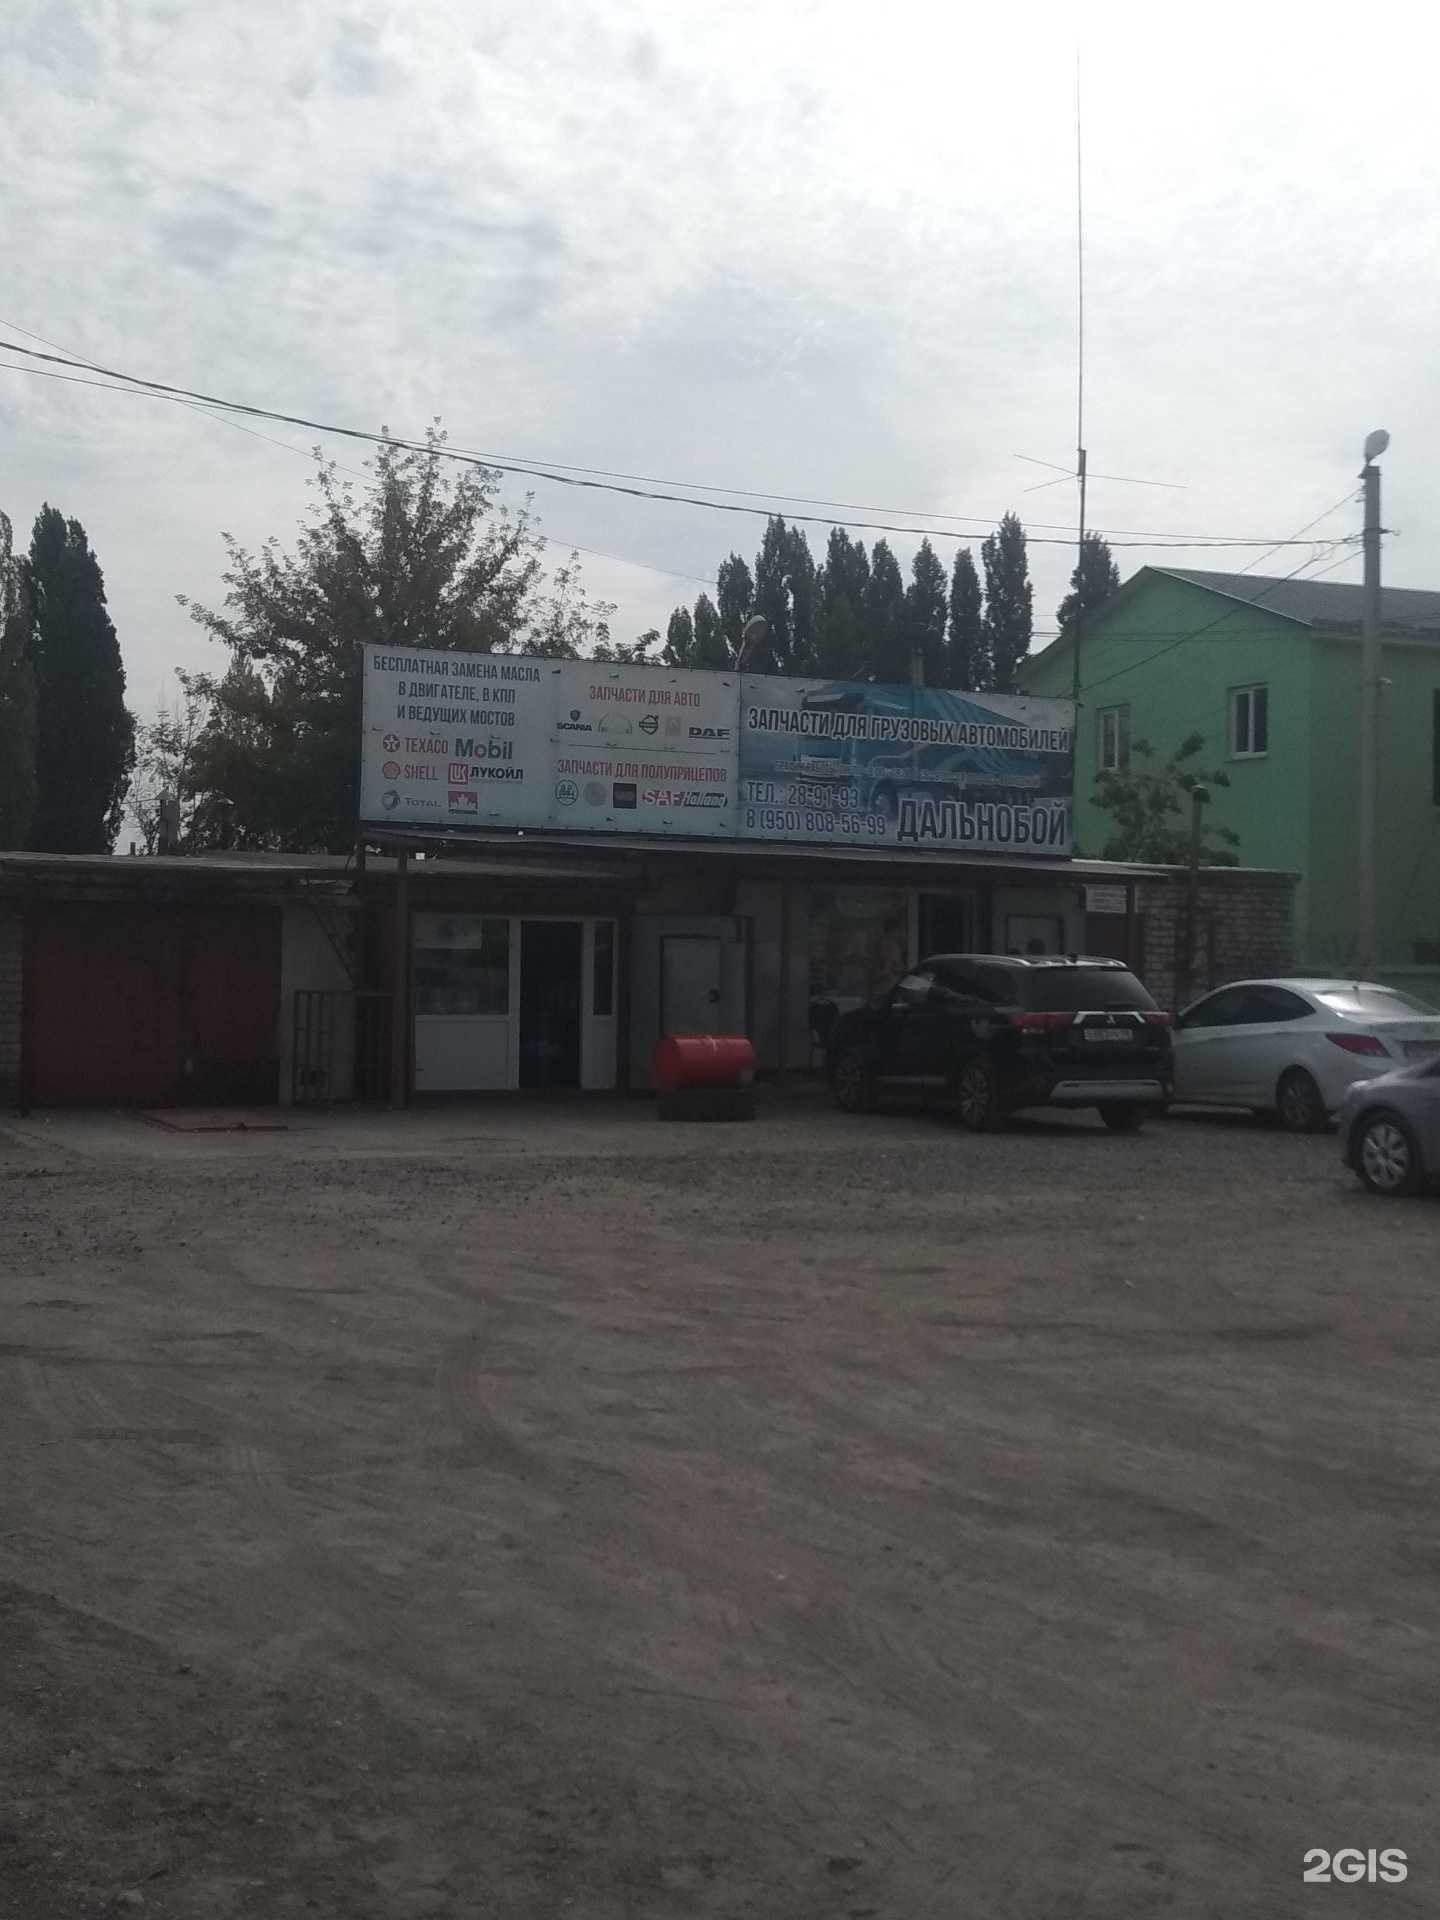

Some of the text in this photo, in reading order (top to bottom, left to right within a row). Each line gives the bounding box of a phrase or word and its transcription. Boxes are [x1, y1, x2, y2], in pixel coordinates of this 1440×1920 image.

[373, 656, 540, 682] БЕСПЛАТНАЯ ЗАМЕНА МАСЛА
[399, 681, 515, 704] В ДВИГАТЕЛЕ, В КПП
[589, 685, 700, 707] ЗАПЧАСТИ ДЛЯ АВТО
[397, 705, 515, 727] И ВЕДУЩИХ МОСТОВ
[689, 727, 730, 737] DAF
[749, 708, 1069, 752] ЗАПЧАСТИ ДЛЯ ГРУЗОВЫХ АВТОМОБИЛЕЙ
[404, 737, 448, 754] TEXACO
[455, 738, 513, 760] Mobil
[404, 764, 438, 780] SHELL
[470, 766, 523, 781] ЛУКОЙЛ
[558, 760, 727, 783] ЗАПЧАСТИ ДЛЯ ПОЛУПРИЦЕПОВ
[746, 809, 756, 829] 8
[760, 810, 800, 831] (950)
[897, 798, 1065, 846] ДАЛЬНОБОЙ
